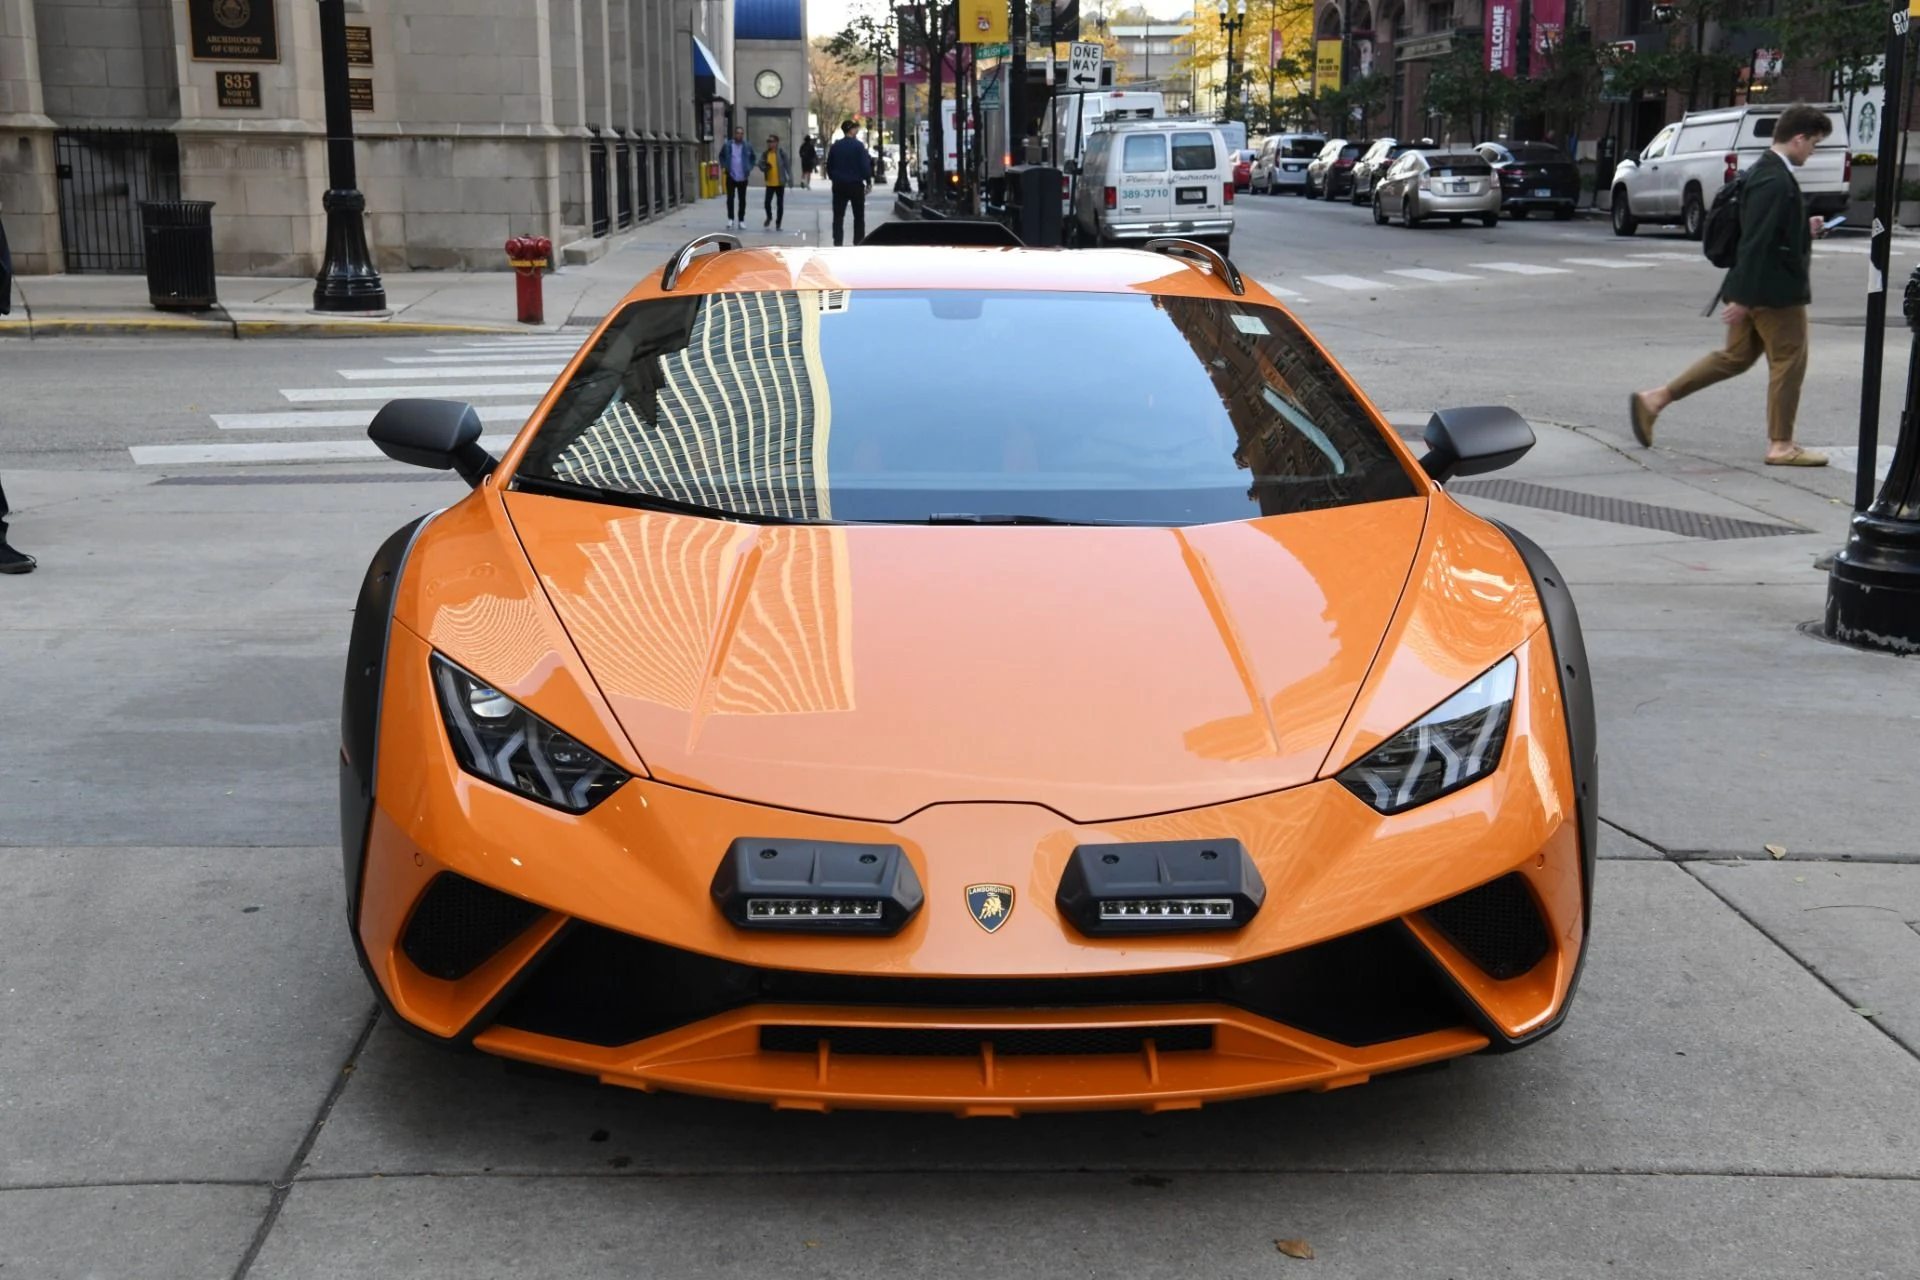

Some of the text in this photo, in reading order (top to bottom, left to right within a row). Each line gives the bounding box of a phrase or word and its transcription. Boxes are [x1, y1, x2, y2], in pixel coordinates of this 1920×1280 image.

[207, 35, 262, 44] ARCHDIOCESE
[1490, 5, 1504, 71] WELCOME
[211, 44, 259, 54] OF CHICAGO
[1074, 46, 1098, 59] ONE
[1073, 59, 1098, 71] WAY
[224, 74, 252, 89] 835
[1122, 188, 1169, 199] 389-3710
[969, 885, 1011, 895] LAMBORGHINI
